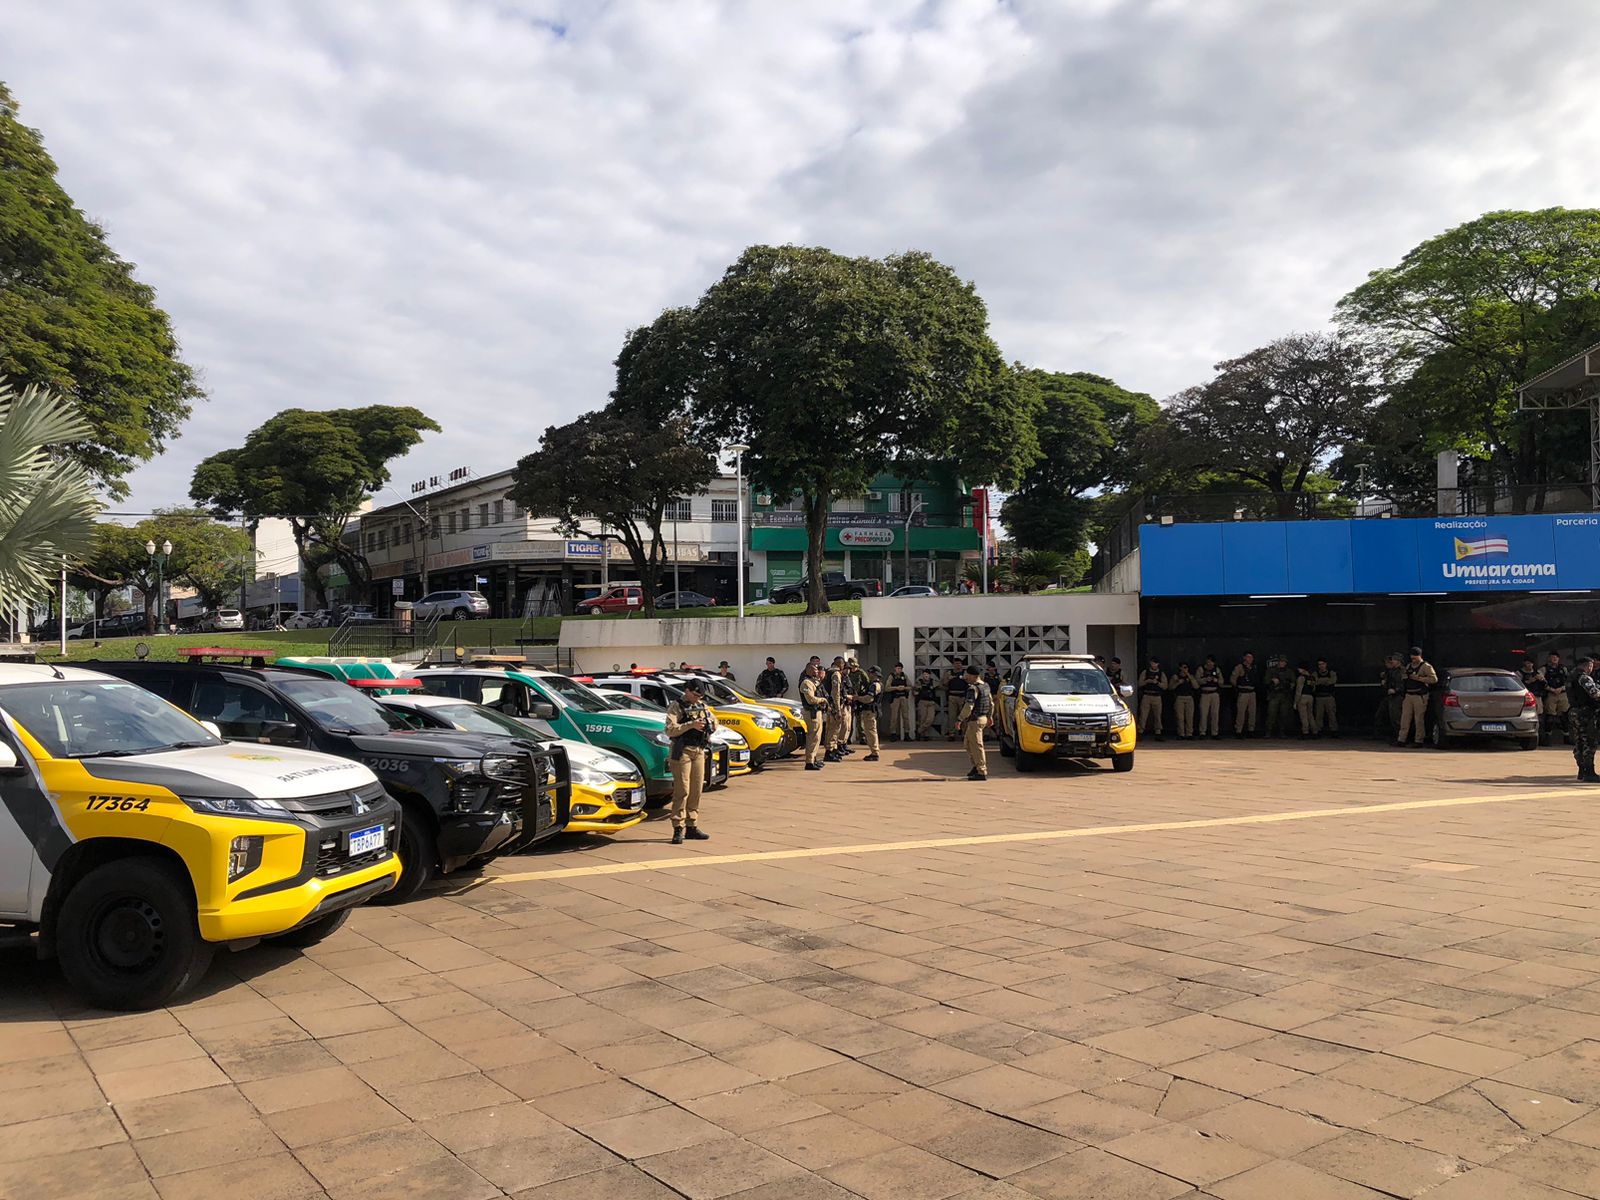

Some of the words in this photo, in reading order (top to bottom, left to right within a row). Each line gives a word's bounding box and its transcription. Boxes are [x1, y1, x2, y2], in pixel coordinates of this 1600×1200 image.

[1434, 520, 1488, 530] Realização
[1556, 517, 1598, 526] Parceria
[569, 543, 599, 553] TIGRE
[1442, 563, 1556, 578] Umuarama
[585, 724, 613, 733] 15915
[86, 795, 151, 812] 17364
